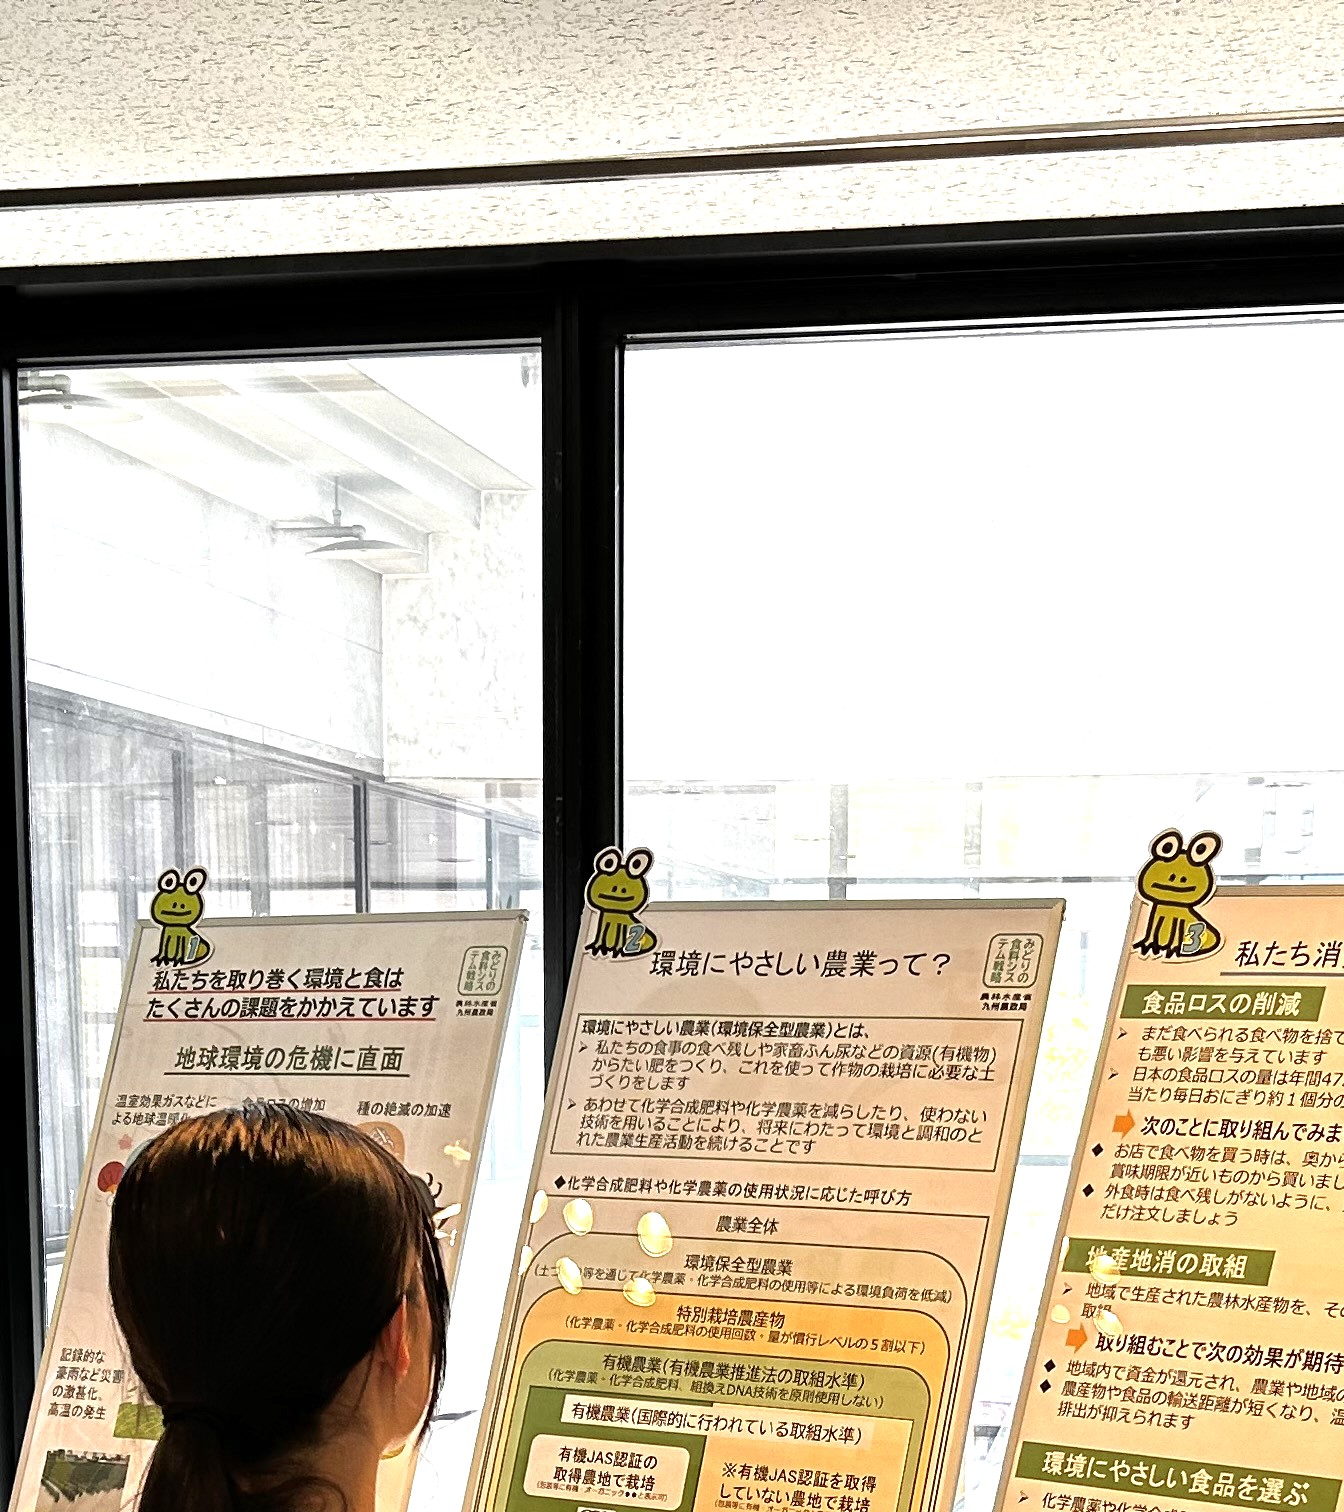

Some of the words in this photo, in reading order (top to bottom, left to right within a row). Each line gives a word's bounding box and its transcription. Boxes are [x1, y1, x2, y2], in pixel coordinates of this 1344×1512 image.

[649, 950, 951, 978] 環境にやさしい農業って？
[153, 967, 404, 991] 私たちを取り巻く環境と食は
[146, 996, 440, 1019] たくさんの課題をかかえています
[1141, 989, 1302, 1017] 食品ロスの削減
[175, 1045, 405, 1072] 地球環境の危機に直面
[1138, 1046, 1324, 1066] も悪い影響を与えています
[589, 1075, 688, 1091] づくりをします
[115, 1094, 218, 1109] 温室効果ガスなどに
[357, 1102, 452, 1118] 種の絶滅の加速
[584, 1097, 988, 1124] あわせて化学合成肥料や化学農薬を減らしたり、使わない
[580, 1114, 983, 1145] 技術を用いることにより、将来にわたって環境と調和のと
[576, 1131, 816, 1154] れた農業生産活動を続けることです
[716, 1215, 779, 1235] 農業全体
[1101, 1204, 1239, 1227] だけ注文しましょう
[684, 1254, 794, 1276] 環境保全型農業
[1085, 1246, 1248, 1280] 地産地消の取組
[676, 1304, 786, 1328] 特別栽培農産物
[60, 1348, 105, 1363] 記録的な
[56, 1366, 125, 1384] 豪雨など災害
[47, 1402, 107, 1420] 高温の発生
[1057, 1401, 1196, 1431] 排出が抑えられます
[558, 1446, 658, 1470] 有機JAS認証の
[553, 1466, 655, 1491] 取得農地で栽培
[1041, 1450, 1309, 1506] 環境にやさしい食品を選ぶ
